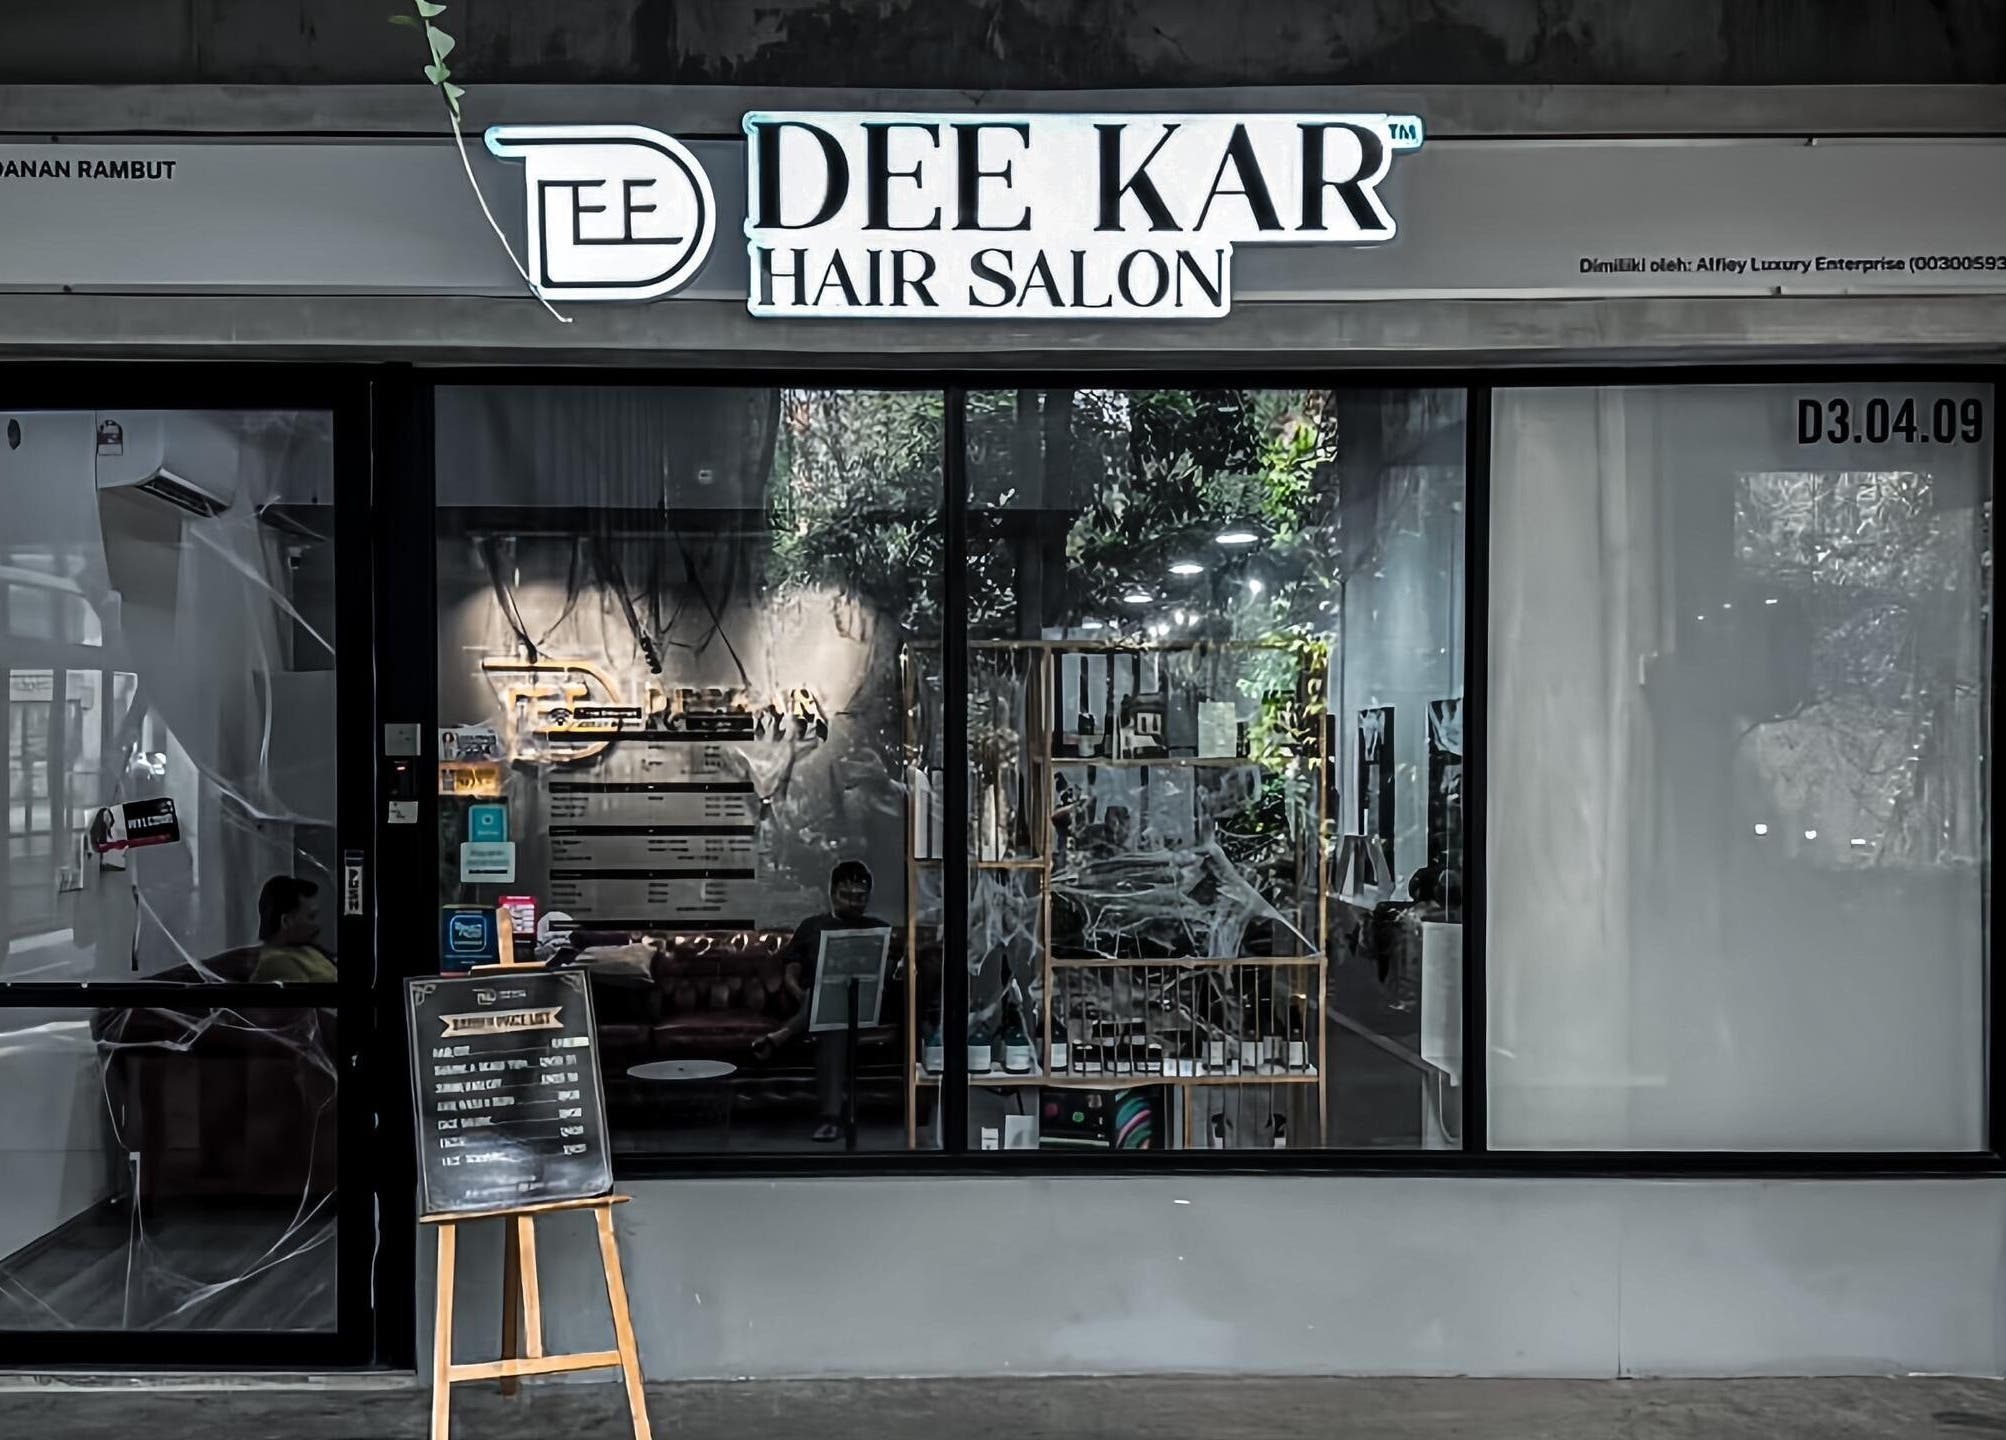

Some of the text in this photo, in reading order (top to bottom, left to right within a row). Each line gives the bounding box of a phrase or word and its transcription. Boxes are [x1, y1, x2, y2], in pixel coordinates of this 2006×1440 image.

[0, 160, 176, 179] ANAN RAMBUT
[750, 121, 1031, 231] DEE
[1093, 122, 1387, 231] KAR
[756, 247, 1224, 308] HAIR SALON
[1750, 257, 1813, 274] Luxury
[1815, 256, 1905, 274] Enterprise
[1798, 398, 1983, 443] D3.04.09
